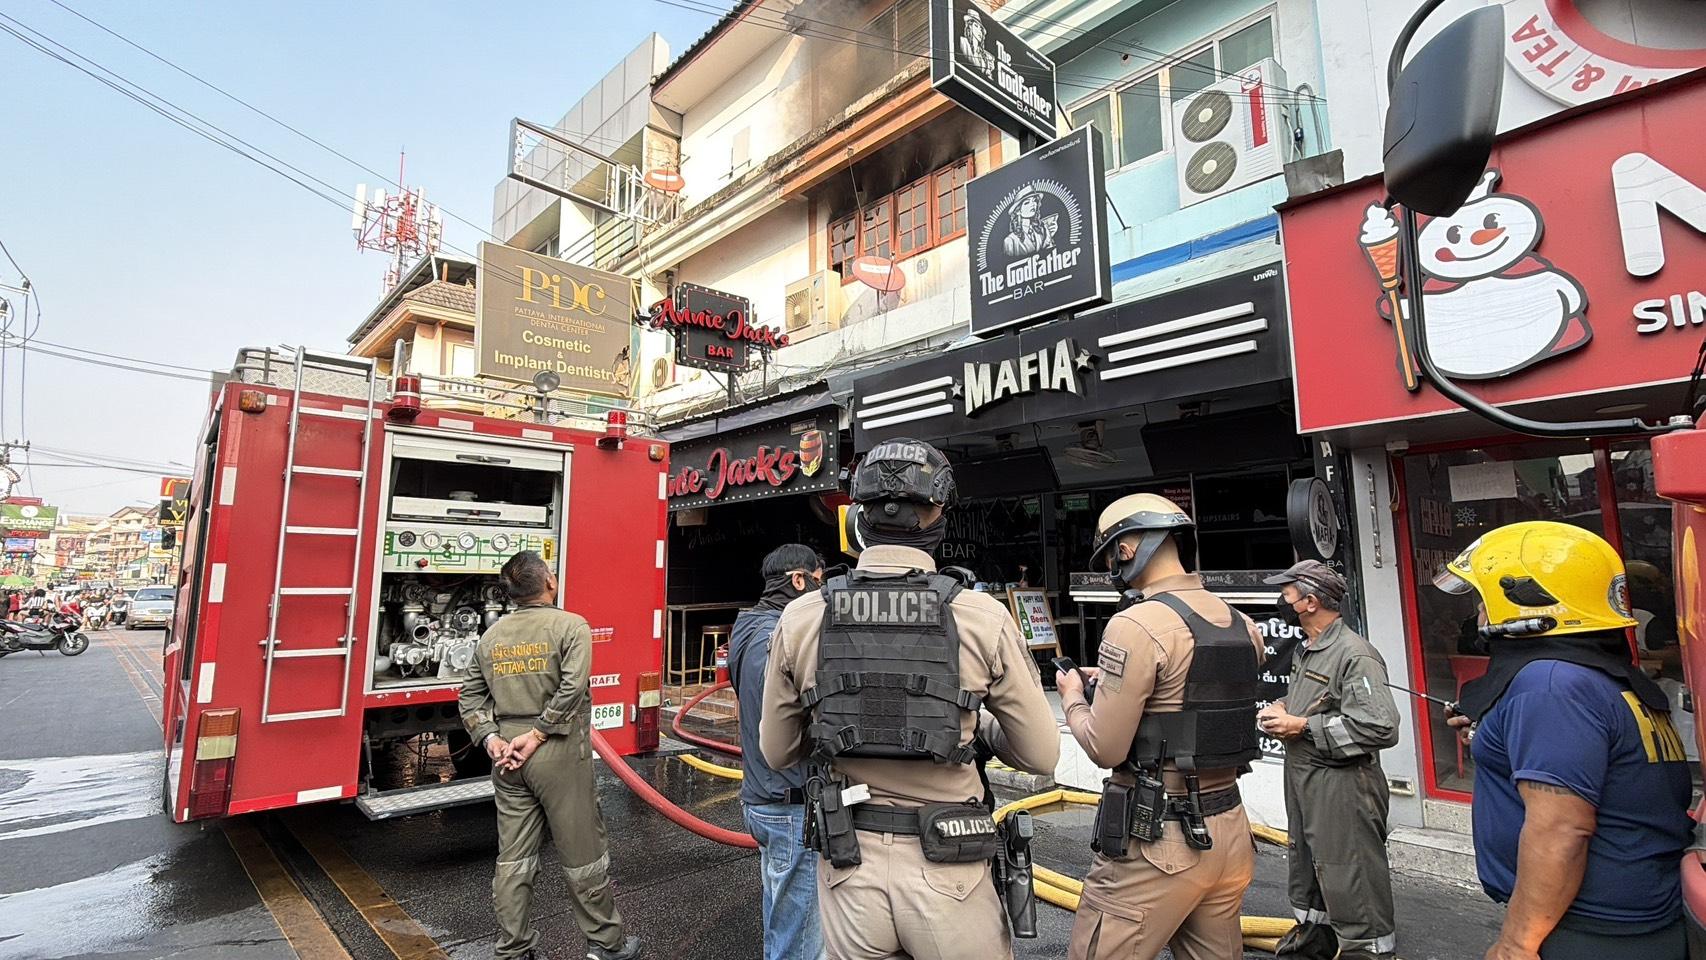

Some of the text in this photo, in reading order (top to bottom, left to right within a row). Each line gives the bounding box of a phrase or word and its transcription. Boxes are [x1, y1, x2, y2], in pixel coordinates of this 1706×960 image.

[995, 40, 1012, 66] The
[1511, 14, 1573, 78] TEA
[997, 61, 1053, 119] Godfather
[1016, 99, 1037, 120] BAR
[979, 247, 1081, 296] The Godfather
[1013, 281, 1044, 300] BAR
[514, 306, 606, 331] PATTAYA INTERNATIONAL
[530, 319, 589, 336] DENTAL CENTER
[650, 297, 790, 350] Annie Jack's
[522, 329, 592, 354] Cosmetic
[708, 344, 734, 358] BAR
[494, 350, 553, 370] Implant
[556, 351, 564, 359] &
[964, 338, 1080, 417] MAFIA
[867, 442, 928, 466] POLICE
[705, 447, 797, 500] Jack's
[942, 543, 976, 559] BAR
[834, 591, 939, 623] POLICE
[493, 658, 548, 675] PATTAYA CITY
[594, 705, 622, 720] 6668
[937, 817, 996, 837] POLICE
